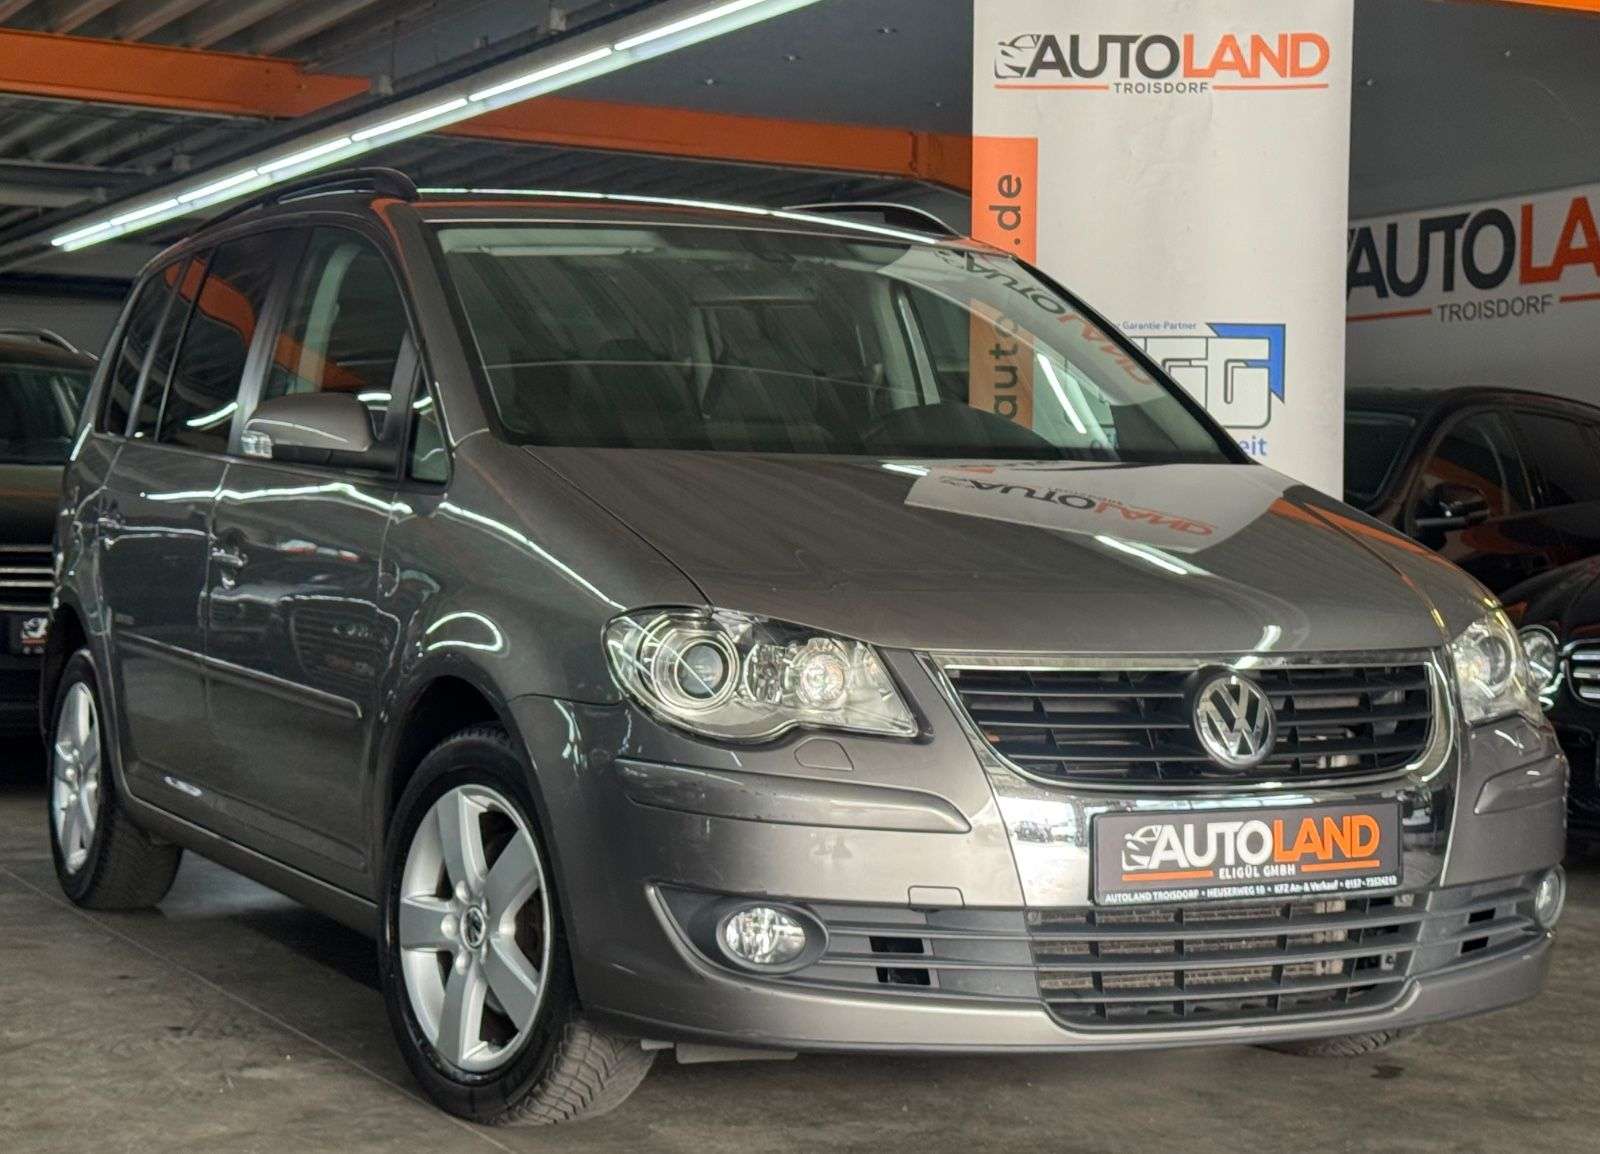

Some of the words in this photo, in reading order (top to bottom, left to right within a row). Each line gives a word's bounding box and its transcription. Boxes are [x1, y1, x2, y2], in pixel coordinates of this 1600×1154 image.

[1026, 32, 1330, 79] AUTOLAND
[1113, 82, 1208, 95] TROISDORF
[1438, 294, 1553, 323] TROISDORF
[1149, 814, 1381, 869] AUTOLAND
[1219, 864, 1260, 880] ELIGÜL
[1263, 863, 1296, 878] GMBH
[1105, 891, 1152, 904] AUTOLAND
[1153, 888, 1200, 902] TROISDORF
